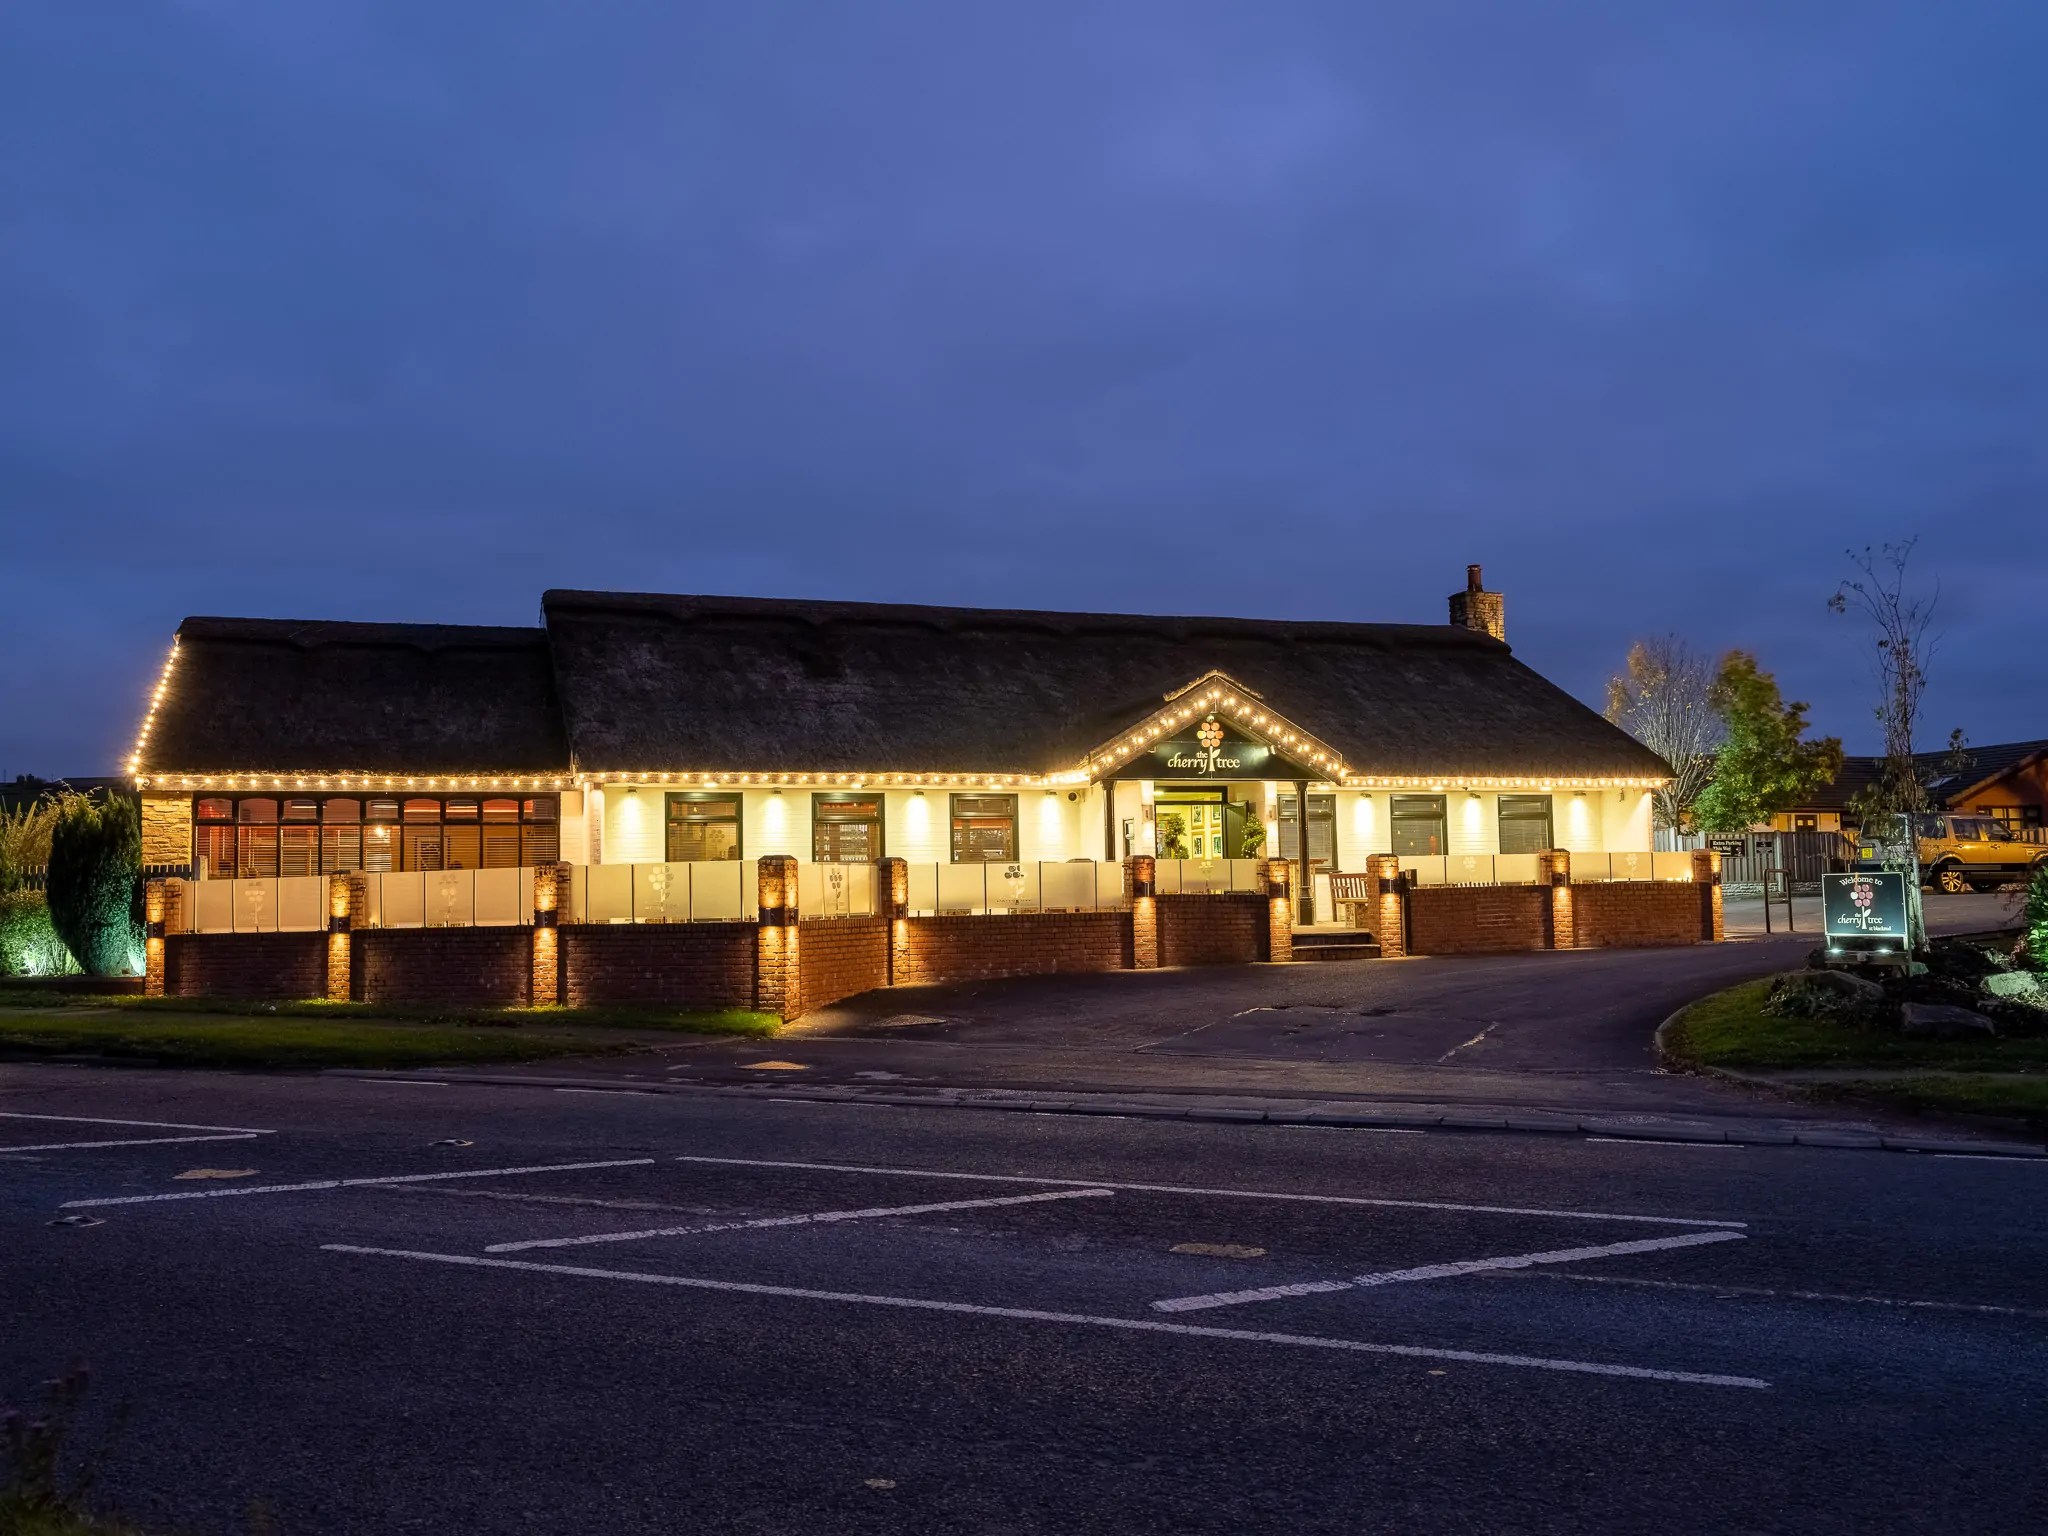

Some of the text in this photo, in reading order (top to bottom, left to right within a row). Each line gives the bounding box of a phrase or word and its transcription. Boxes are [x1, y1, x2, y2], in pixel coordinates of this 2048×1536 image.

[1196, 751, 1208, 759] the
[1167, 752, 1240, 774] cherry tree
[1839, 877, 1883, 886] Welcome to
[1837, 914, 1861, 928] cherry
